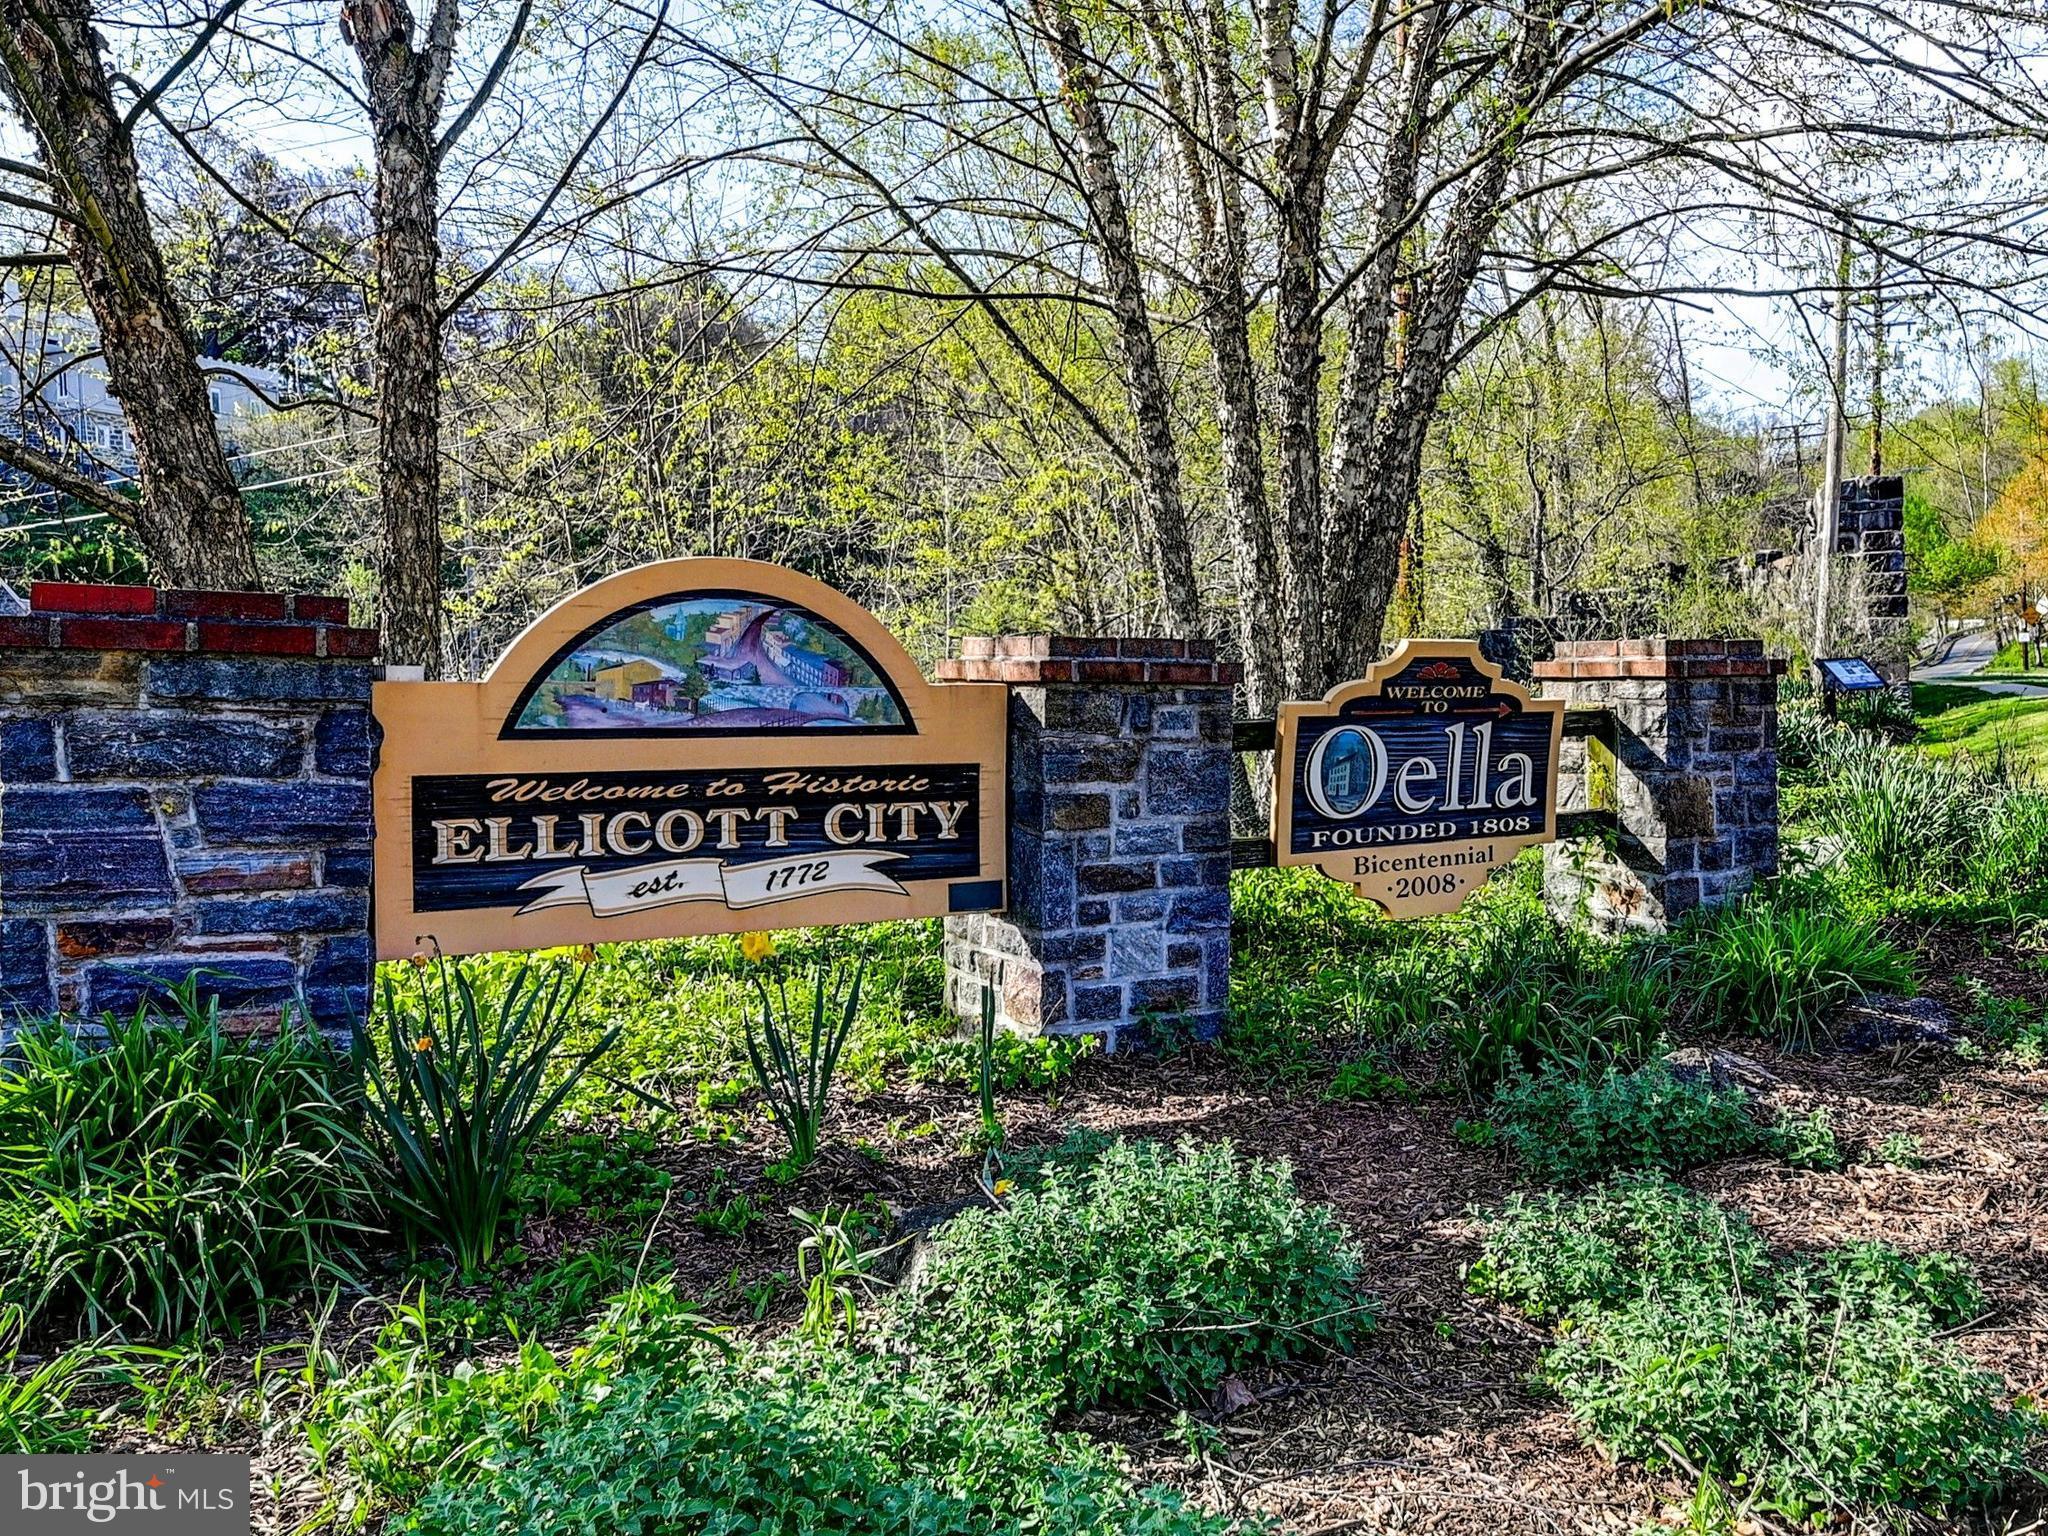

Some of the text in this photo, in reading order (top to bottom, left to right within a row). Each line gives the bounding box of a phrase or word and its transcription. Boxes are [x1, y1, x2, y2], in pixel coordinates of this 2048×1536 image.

[1387, 686, 1486, 699] WELCOME
[1421, 701, 1448, 713] TO
[1304, 721, 1537, 819] Oella
[486, 772, 930, 802] Welcome to Historic
[431, 800, 970, 865] ELLICOTT CITY
[1311, 816, 1530, 847] FOUNDED 1808
[1353, 845, 1494, 876] Bicentennial
[630, 860, 829, 899] est. 1772
